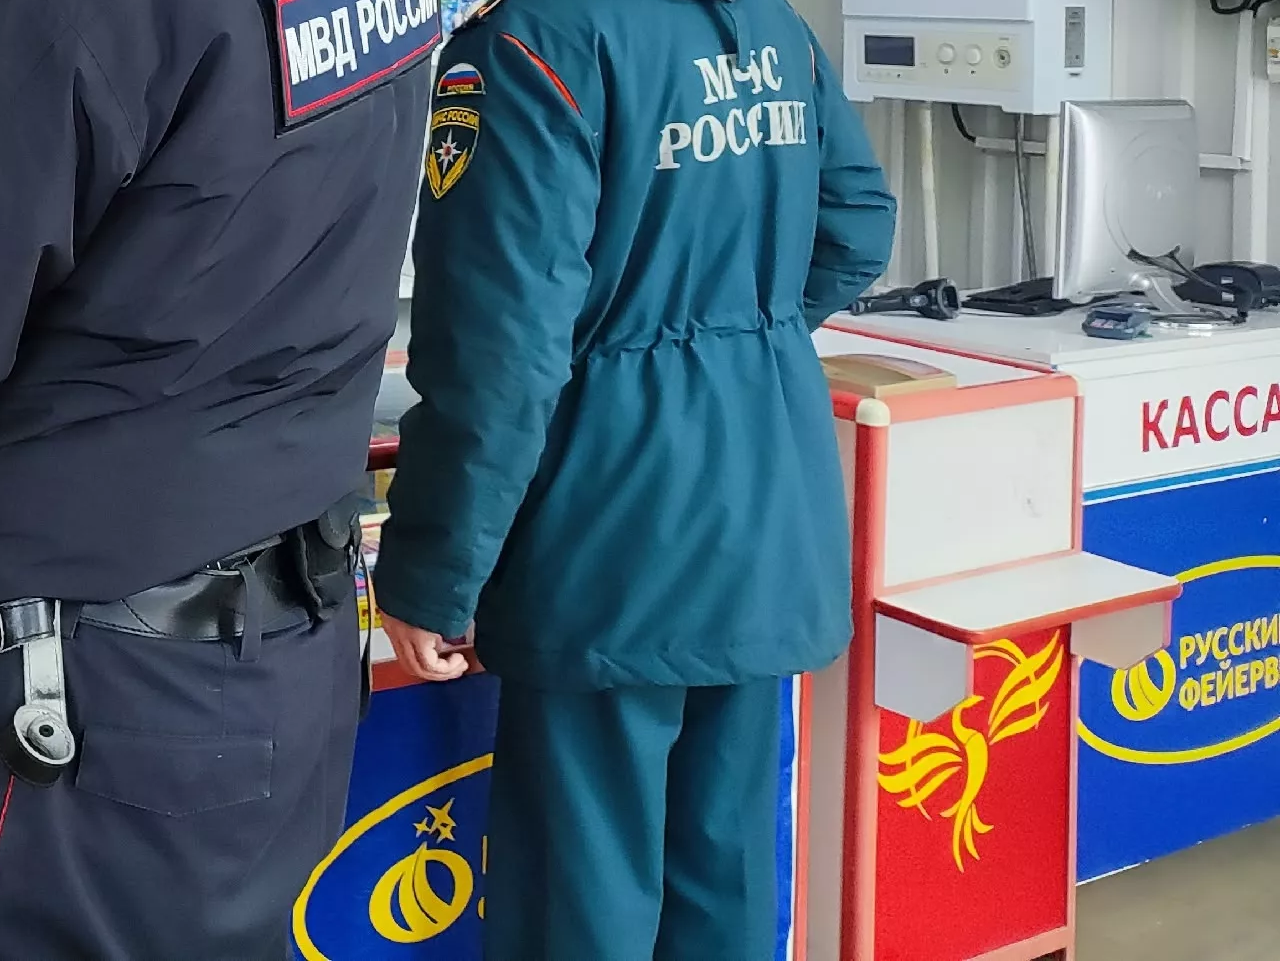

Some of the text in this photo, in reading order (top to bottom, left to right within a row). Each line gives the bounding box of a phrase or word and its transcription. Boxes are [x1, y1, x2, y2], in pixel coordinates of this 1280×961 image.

[285, 5, 359, 86] МВД
[693, 46, 783, 105] МЧС
[655, 101, 807, 170] РОССИИ
[1142, 383, 1280, 453] КАССА
[1179, 612, 1280, 670] РУССКИ
[1178, 654, 1280, 712] ФЕЙЕРВ
